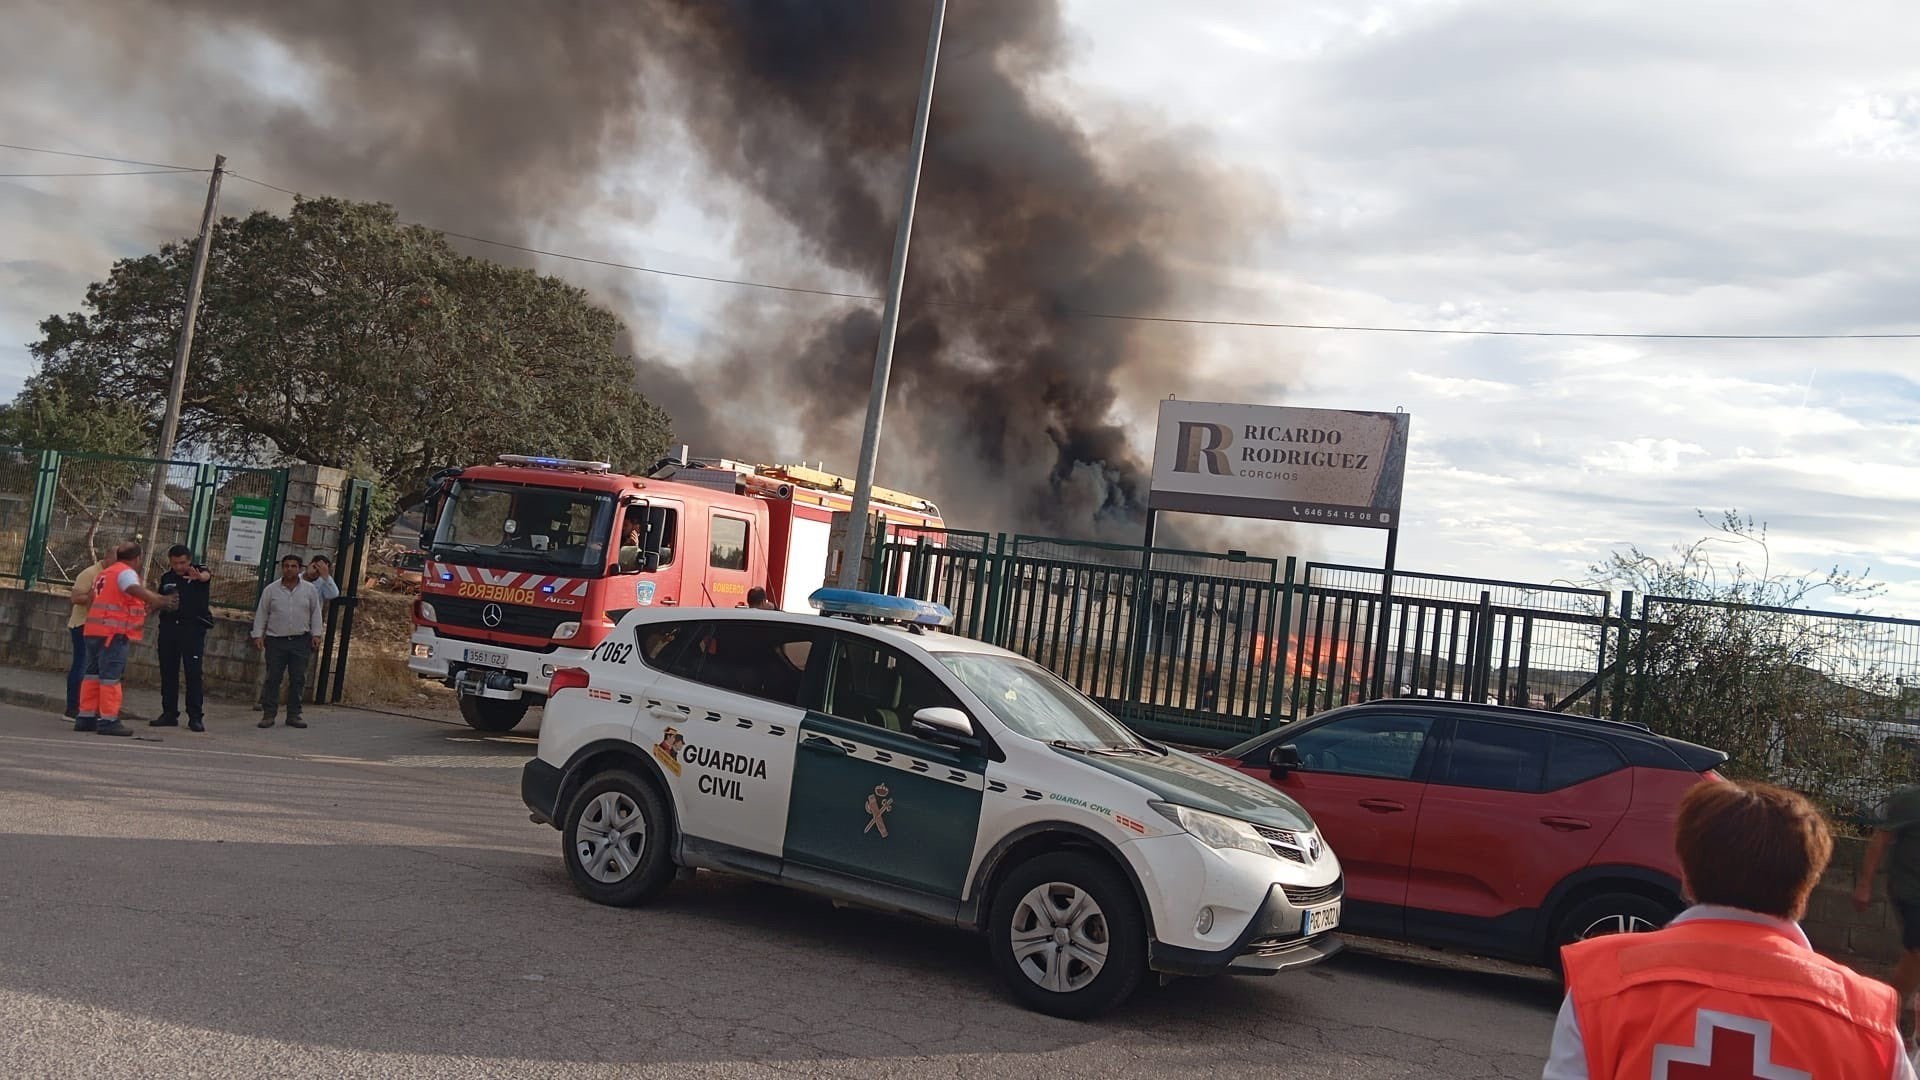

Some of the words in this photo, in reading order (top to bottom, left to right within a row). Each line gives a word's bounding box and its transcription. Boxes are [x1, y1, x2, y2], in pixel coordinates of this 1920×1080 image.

[1243, 424, 1342, 446] RICARDO
[1240, 447, 1369, 471] RODRIGUEZ
[1239, 469, 1299, 481] CORCHOS
[1304, 508, 1322, 517] 646
[1327, 510, 1338, 518] 54
[1344, 511, 1355, 519] 15
[1360, 512, 1372, 520] 08
[712, 582, 745, 594] BOMBEROS
[602, 641, 633, 664] 062
[682, 744, 768, 780] GUARDIA
[698, 774, 744, 802] CIVIL
[1049, 793, 1088, 808] GUARDIA
[1090, 803, 1112, 816] CIVIL
